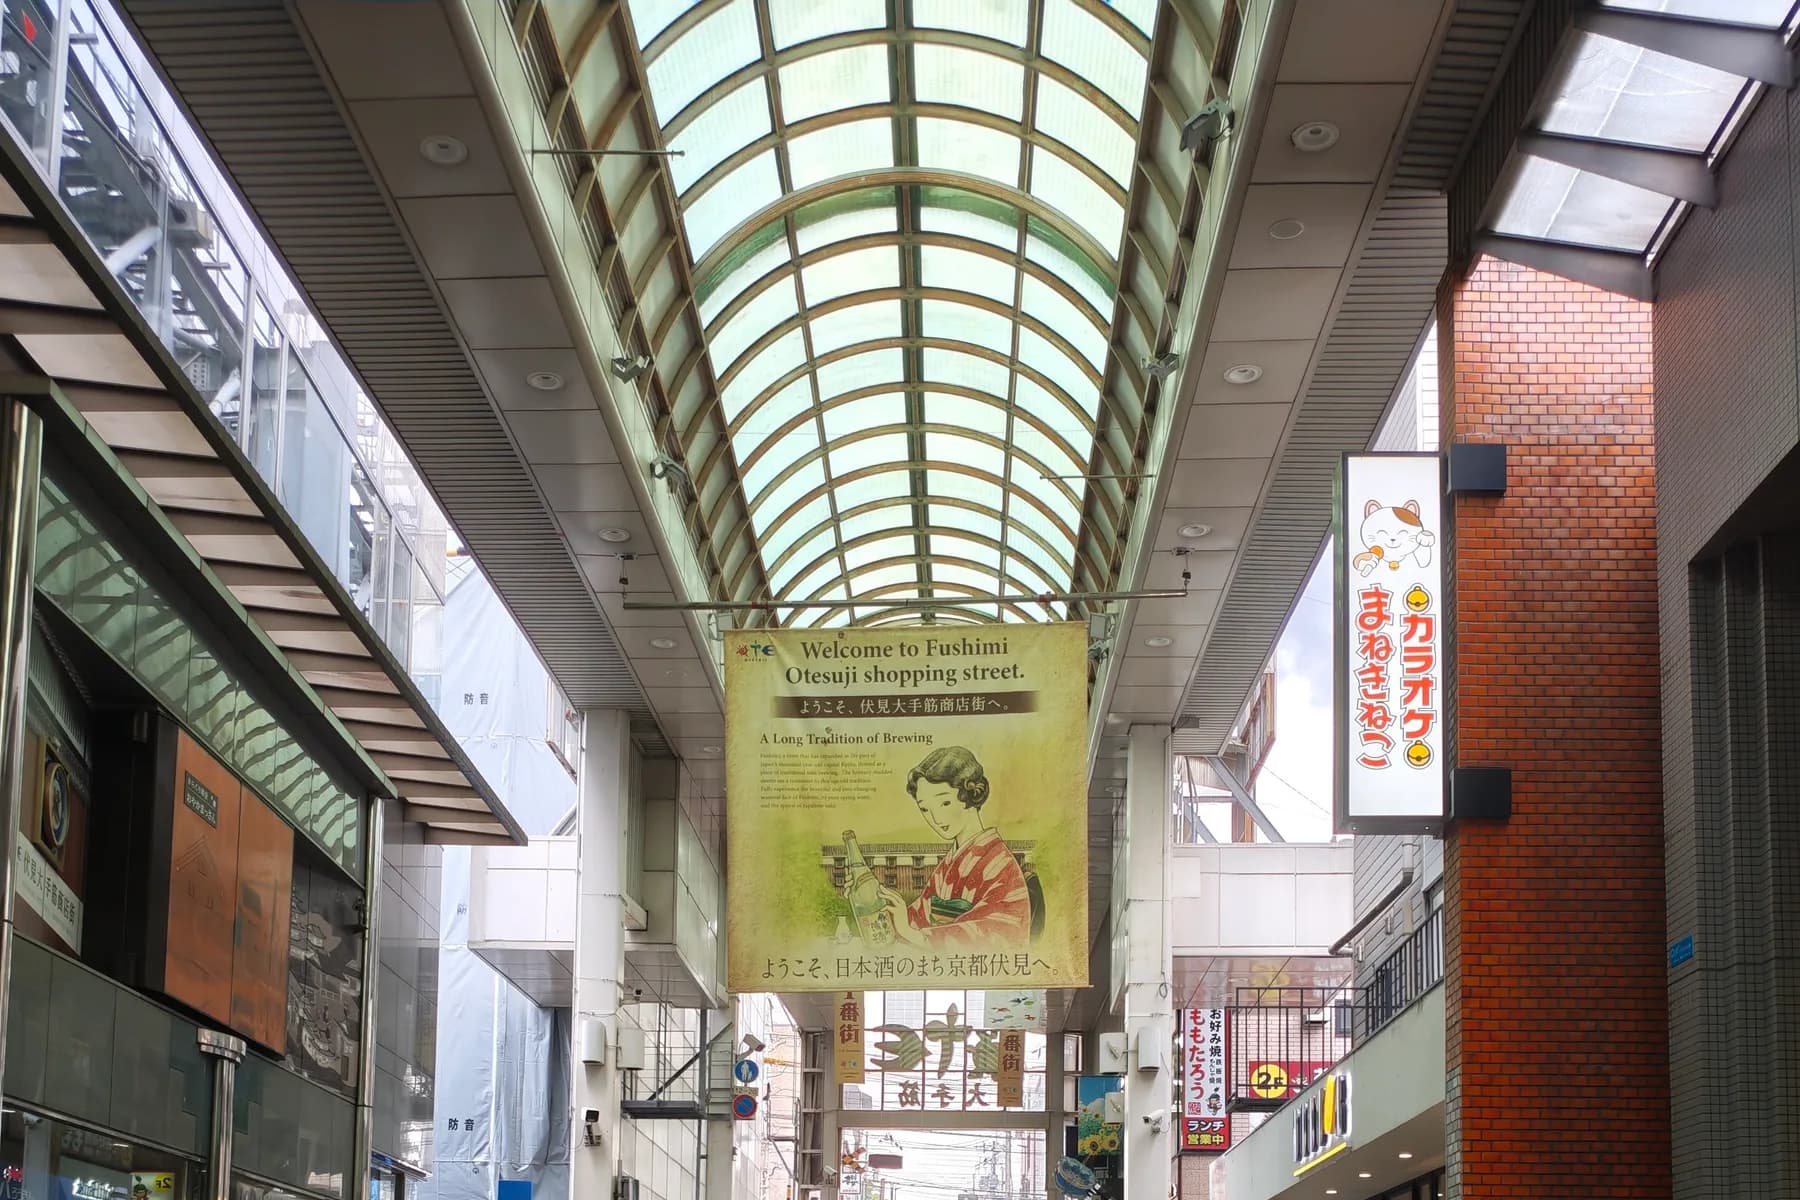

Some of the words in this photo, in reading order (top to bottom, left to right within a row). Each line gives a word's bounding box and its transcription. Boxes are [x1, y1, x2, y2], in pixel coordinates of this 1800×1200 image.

[800, 640, 893, 659] Welcome
[900, 641, 919, 657] to
[926, 637, 1009, 657] Fushimi
[785, 665, 857, 688] Otesuji
[864, 664, 958, 688] shopping
[962, 663, 1025, 681] street.
[1357, 586, 1394, 769] まねきねこ
[1402, 613, 1435, 741] カラオケ
[800, 696, 1009, 715] ようこそ、伏見大手筋商店街へ。
[760, 733, 769, 745] A
[773, 733, 803, 746] Long
[806, 733, 863, 747] Tradition
[867, 732, 880, 744] of
[883, 731, 933, 745] Brewing
[761, 952, 1060, 981] ようこそ、日本酒のまち京都伏見へ。
[1209, 1008, 1222, 1057] お好み焼
[1002, 1030, 1022, 1072] 番街
[1189, 1008, 1206, 1100] ももたろう
[1257, 1071, 1284, 1091] 2F
[448, 1117, 475, 1132] 防音
[1187, 1120, 1225, 1133] ランチ
[1187, 1133, 1225, 1146] 営業中
